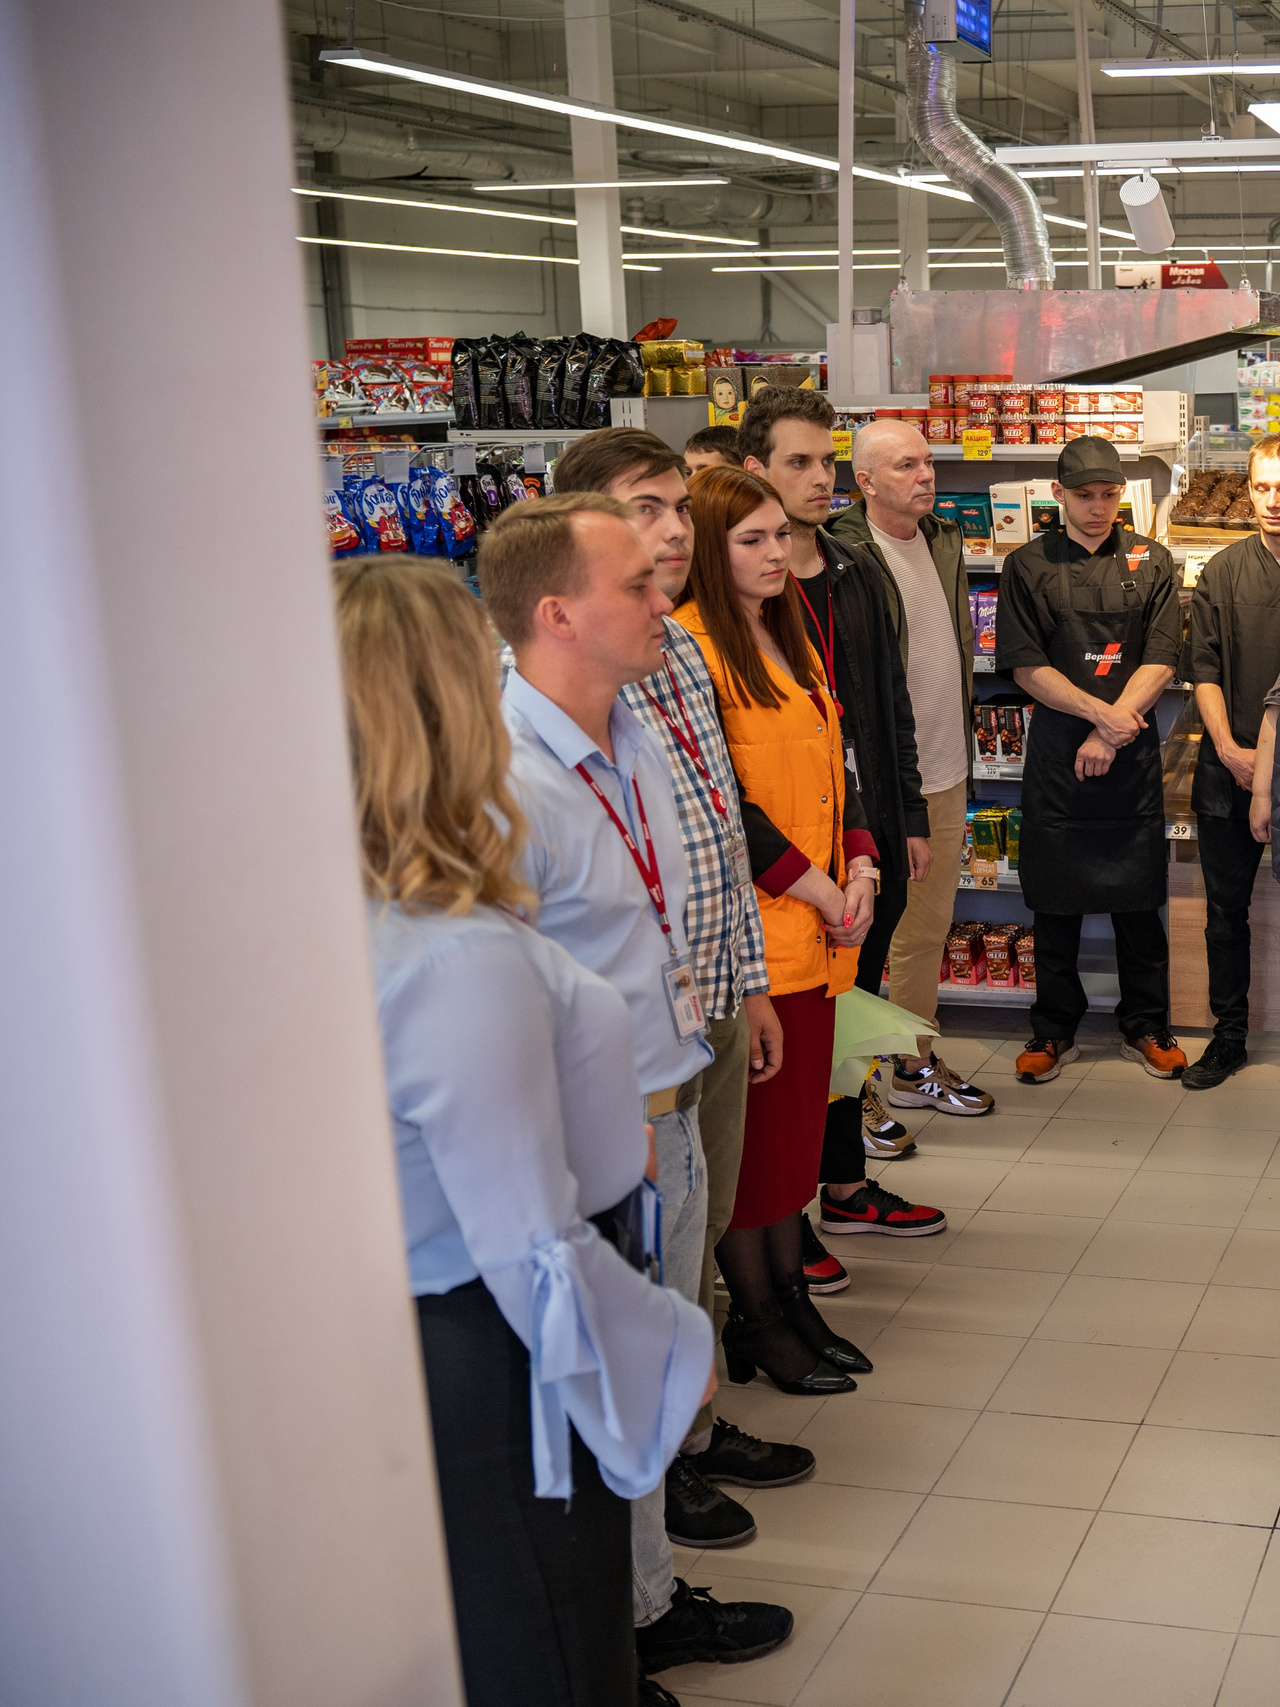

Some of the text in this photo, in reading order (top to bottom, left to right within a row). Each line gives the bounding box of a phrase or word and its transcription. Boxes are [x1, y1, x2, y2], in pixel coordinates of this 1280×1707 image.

[1169, 267, 1205, 276] Мясная
[364, 342, 373, 350] Pie
[405, 341, 415, 349] Pie
[965, 435, 989, 443] АКЦИЯ!
[978, 606, 997, 618] Milk
[1084, 652, 1122, 662] Верный
[1173, 826, 1187, 835] 39
[981, 877, 994, 886] 65
[918, 1082, 943, 1098] AX
